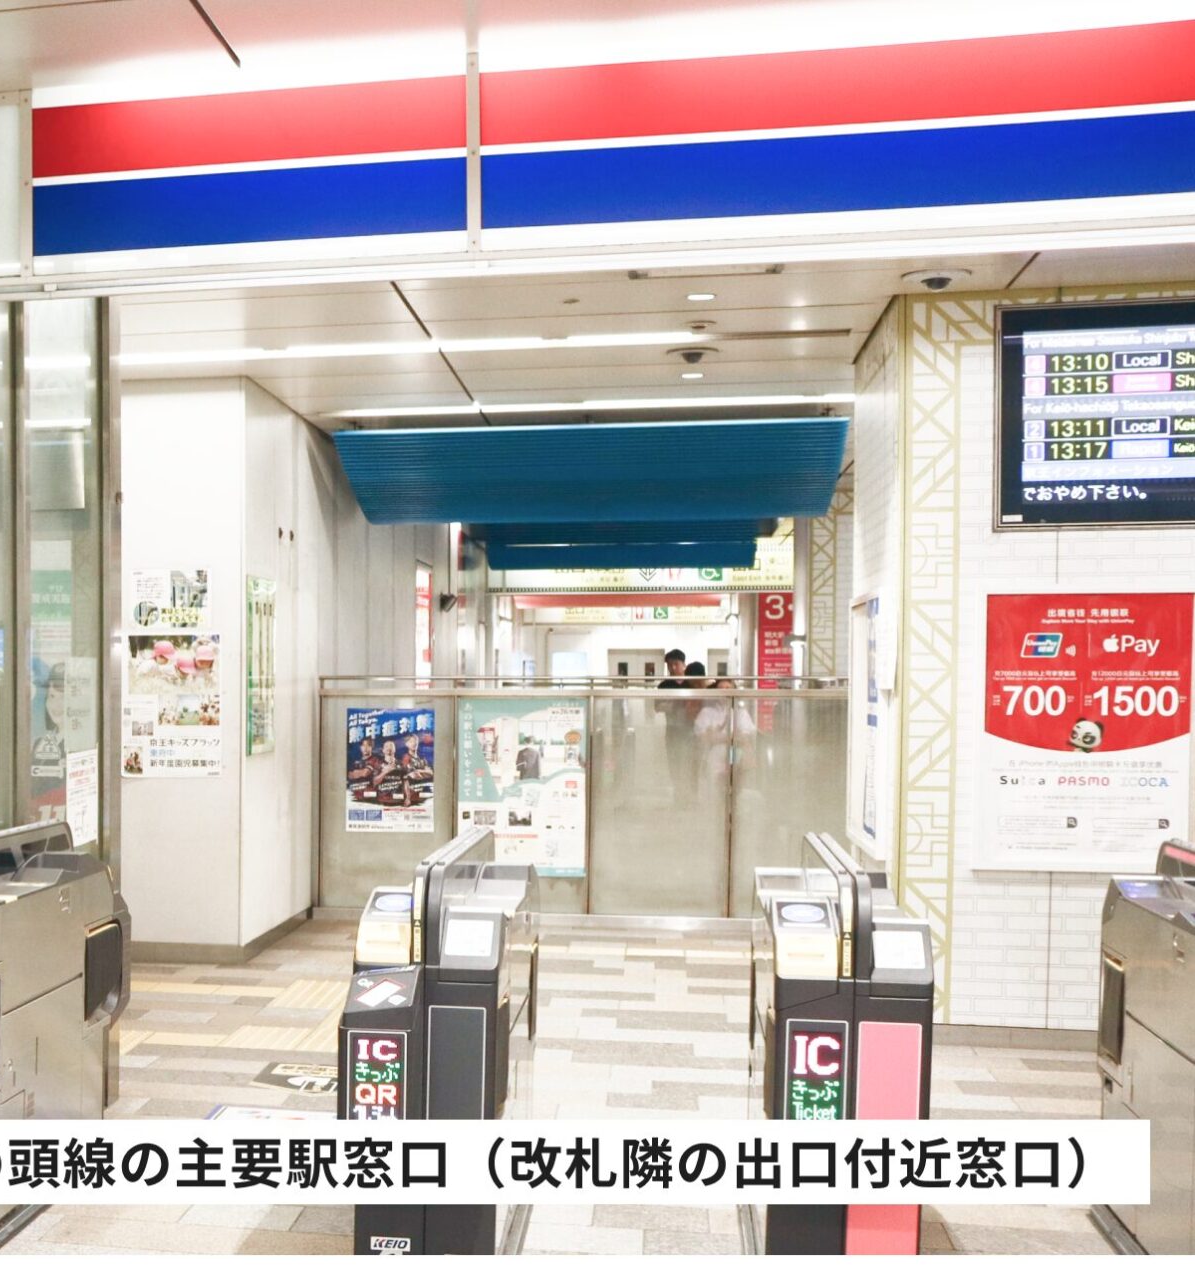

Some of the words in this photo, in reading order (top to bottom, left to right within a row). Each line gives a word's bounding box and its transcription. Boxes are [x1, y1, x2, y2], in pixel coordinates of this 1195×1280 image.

[1051, 354, 1109, 372] 13:10
[1123, 354, 1162, 367] Local
[1051, 376, 1109, 394] 13:15
[1030, 424, 1040, 434] 2
[1050, 420, 1105, 437] 13:11
[1122, 419, 1161, 433] Local
[1031, 446, 1039, 457] 1
[1050, 442, 1107, 459] 13:17
[1023, 484, 1147, 501] でおやめ下さい。
[765, 595, 785, 619] 3
[1121, 635, 1160, 657] Pay
[1002, 685, 1067, 716] 700
[1092, 685, 1179, 717] 1500
[1057, 776, 1110, 786] PASMO
[357, 1038, 398, 1061] IC
[793, 1035, 840, 1075] IC
[355, 1062, 401, 1083] きっぷ
[355, 1084, 397, 1104] QR
[791, 1080, 839, 1101] きっぷ
[792, 1102, 837, 1119] Ticket
[373, 1238, 409, 1250] KEIO
